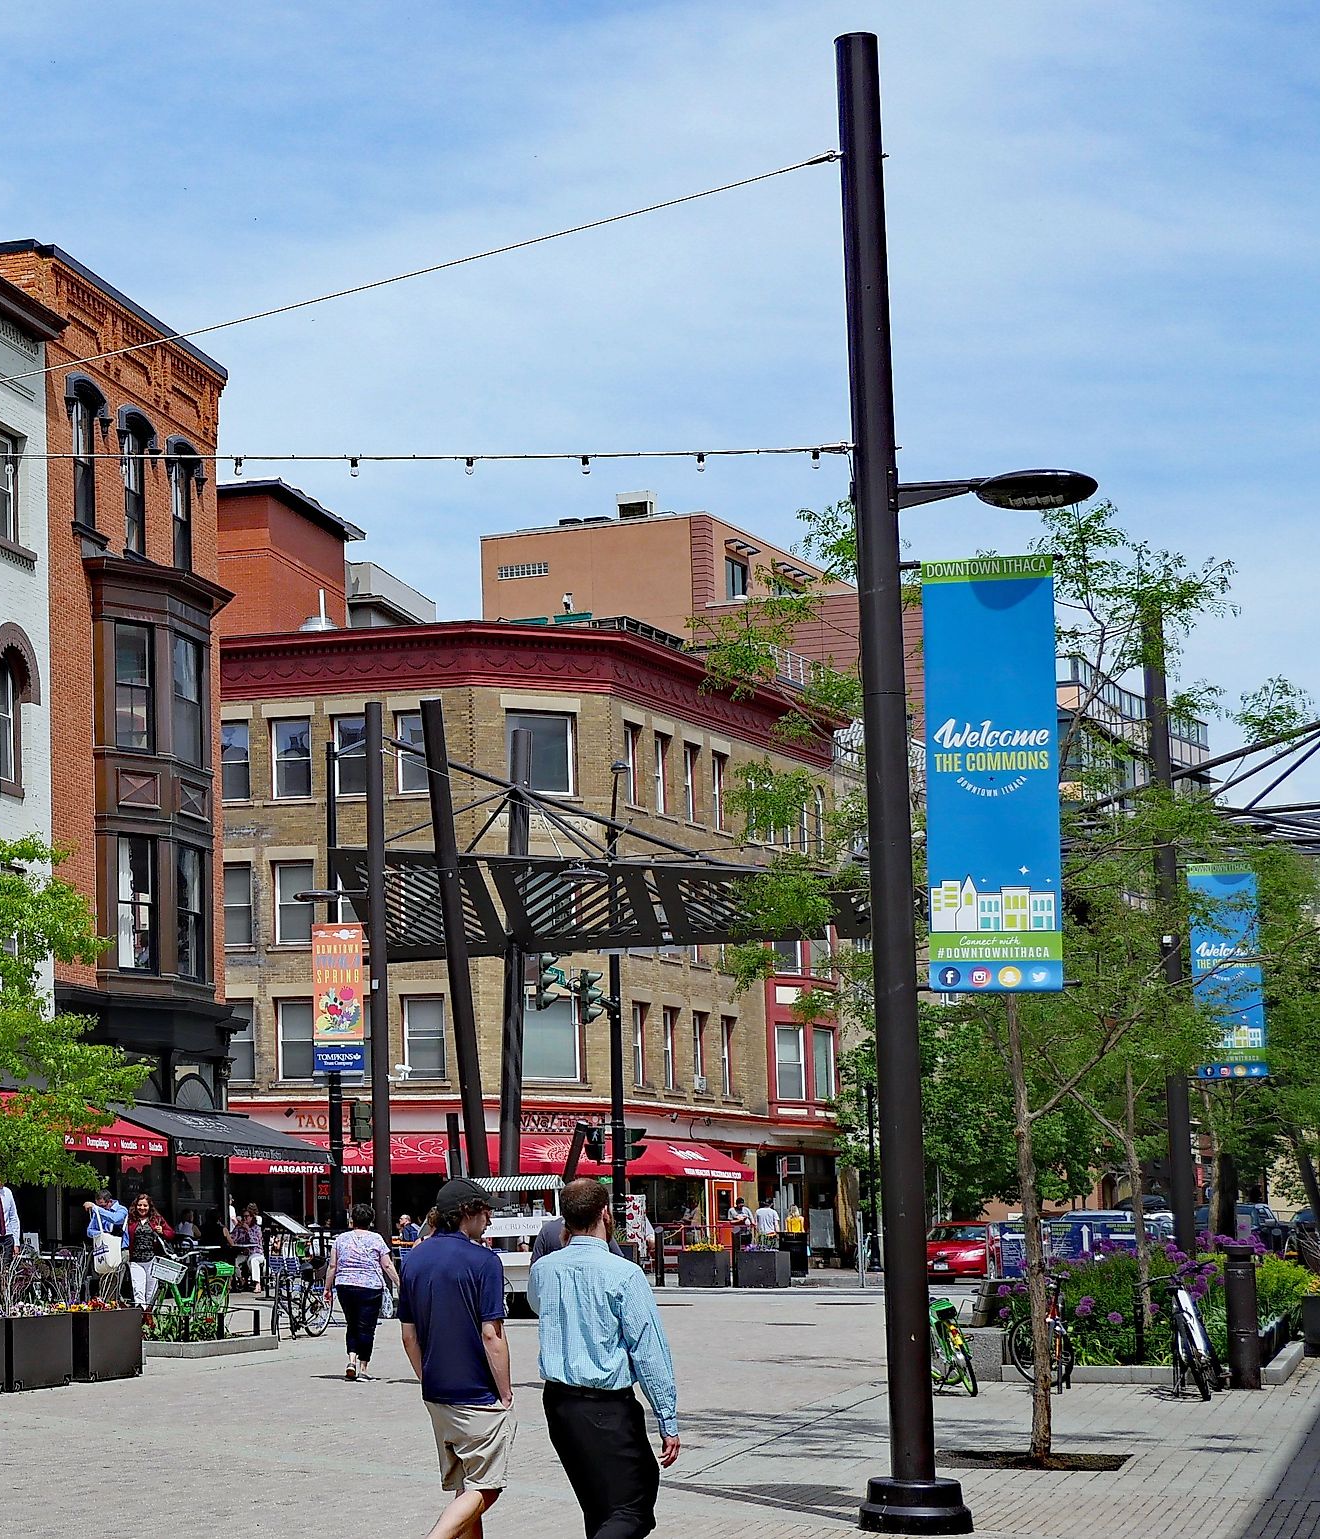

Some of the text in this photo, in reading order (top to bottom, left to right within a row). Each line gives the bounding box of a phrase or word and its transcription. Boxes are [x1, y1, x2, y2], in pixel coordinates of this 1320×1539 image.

[926, 558, 1047, 578] DOWNTOWN ITHACA
[933, 717, 1049, 749] Welcome
[934, 750, 1049, 772] THE COMMONS
[956, 775, 1028, 797] DOWNTOWN ITHACA
[959, 935, 1021, 946] Connect with
[316, 943, 359, 955] DOWNTOWN
[937, 946, 1050, 959] #DOWNTOWNITHACA
[317, 968, 359, 984] SPRING
[316, 1053, 354, 1062] TOMPKINS
[86, 1136, 110, 1149] Dumplings
[120, 1139, 138, 1150] Noodles
[269, 1165, 325, 1174] MARGARITAS
[341, 1165, 367, 1174] QUILA
[522, 1222, 540, 1230] Store
